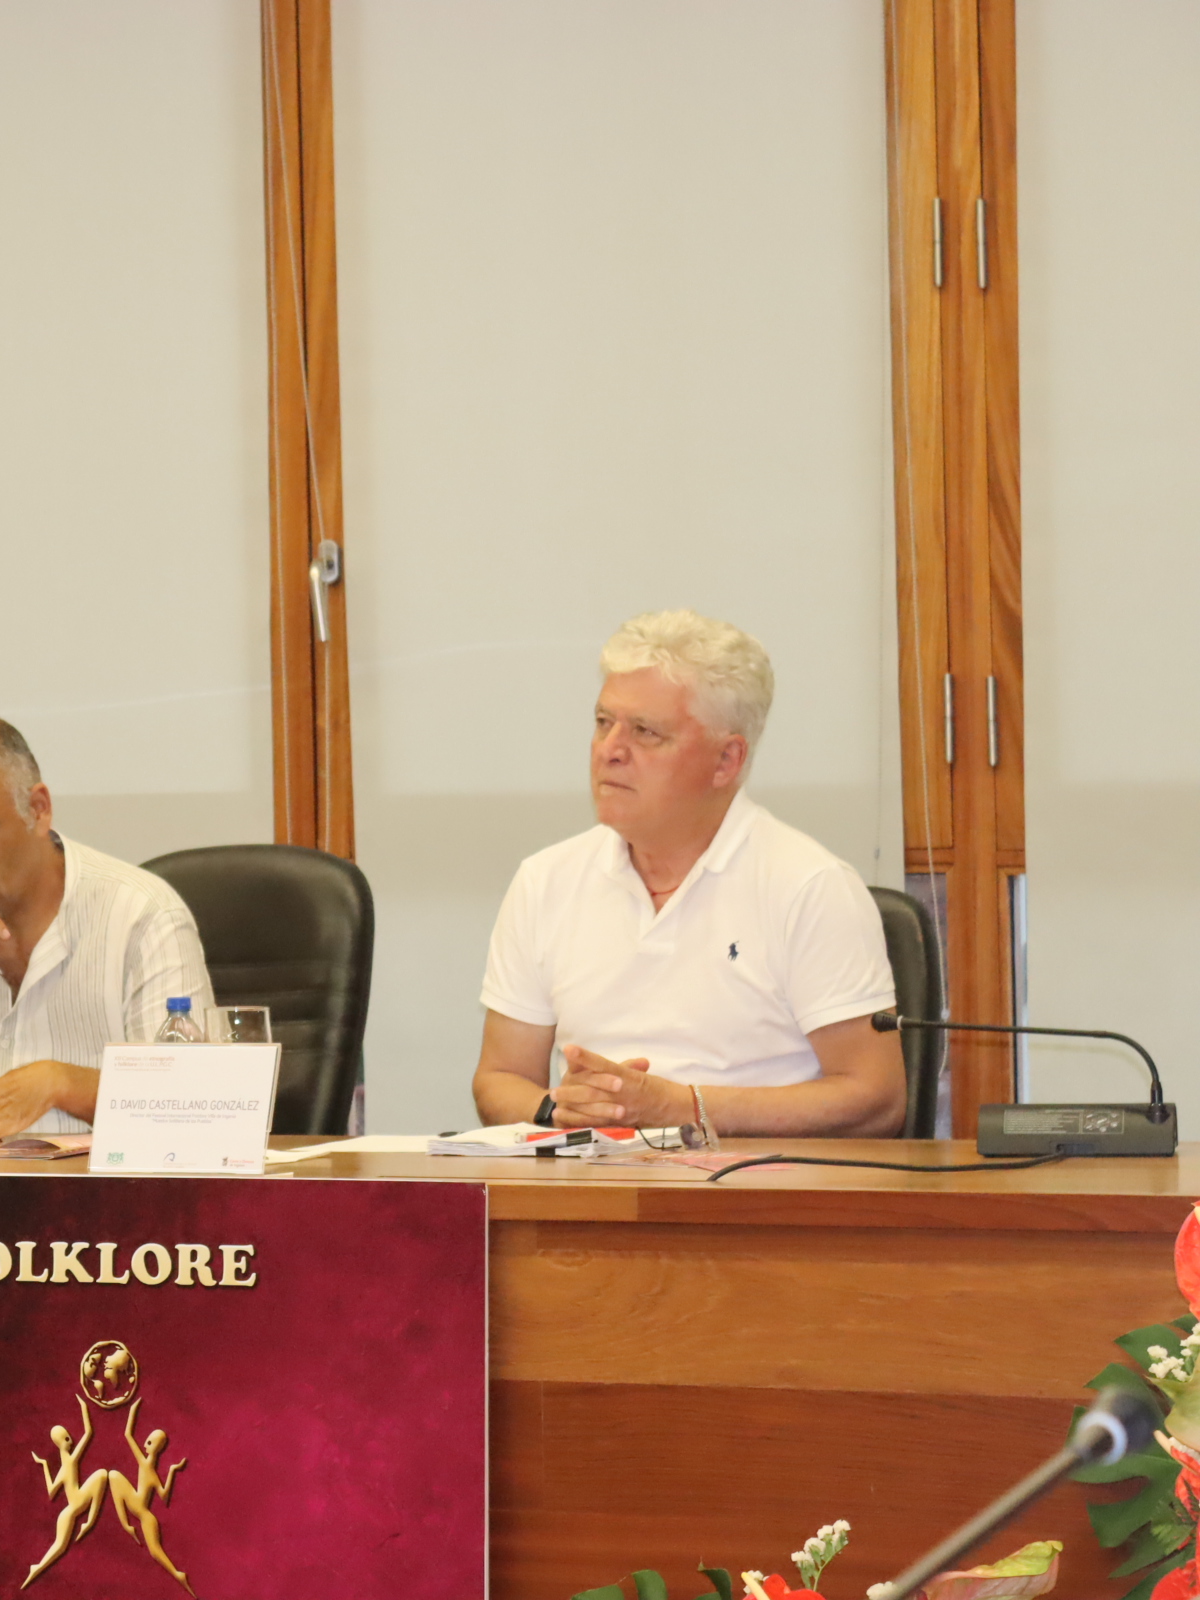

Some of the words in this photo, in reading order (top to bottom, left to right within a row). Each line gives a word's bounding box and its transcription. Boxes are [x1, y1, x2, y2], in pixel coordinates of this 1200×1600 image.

[110, 1099, 118, 1110] D.
[120, 1099, 147, 1110] DAVID
[148, 1099, 208, 1111] CASTELLANO
[210, 1097, 260, 1111] GONZÁLEZ
